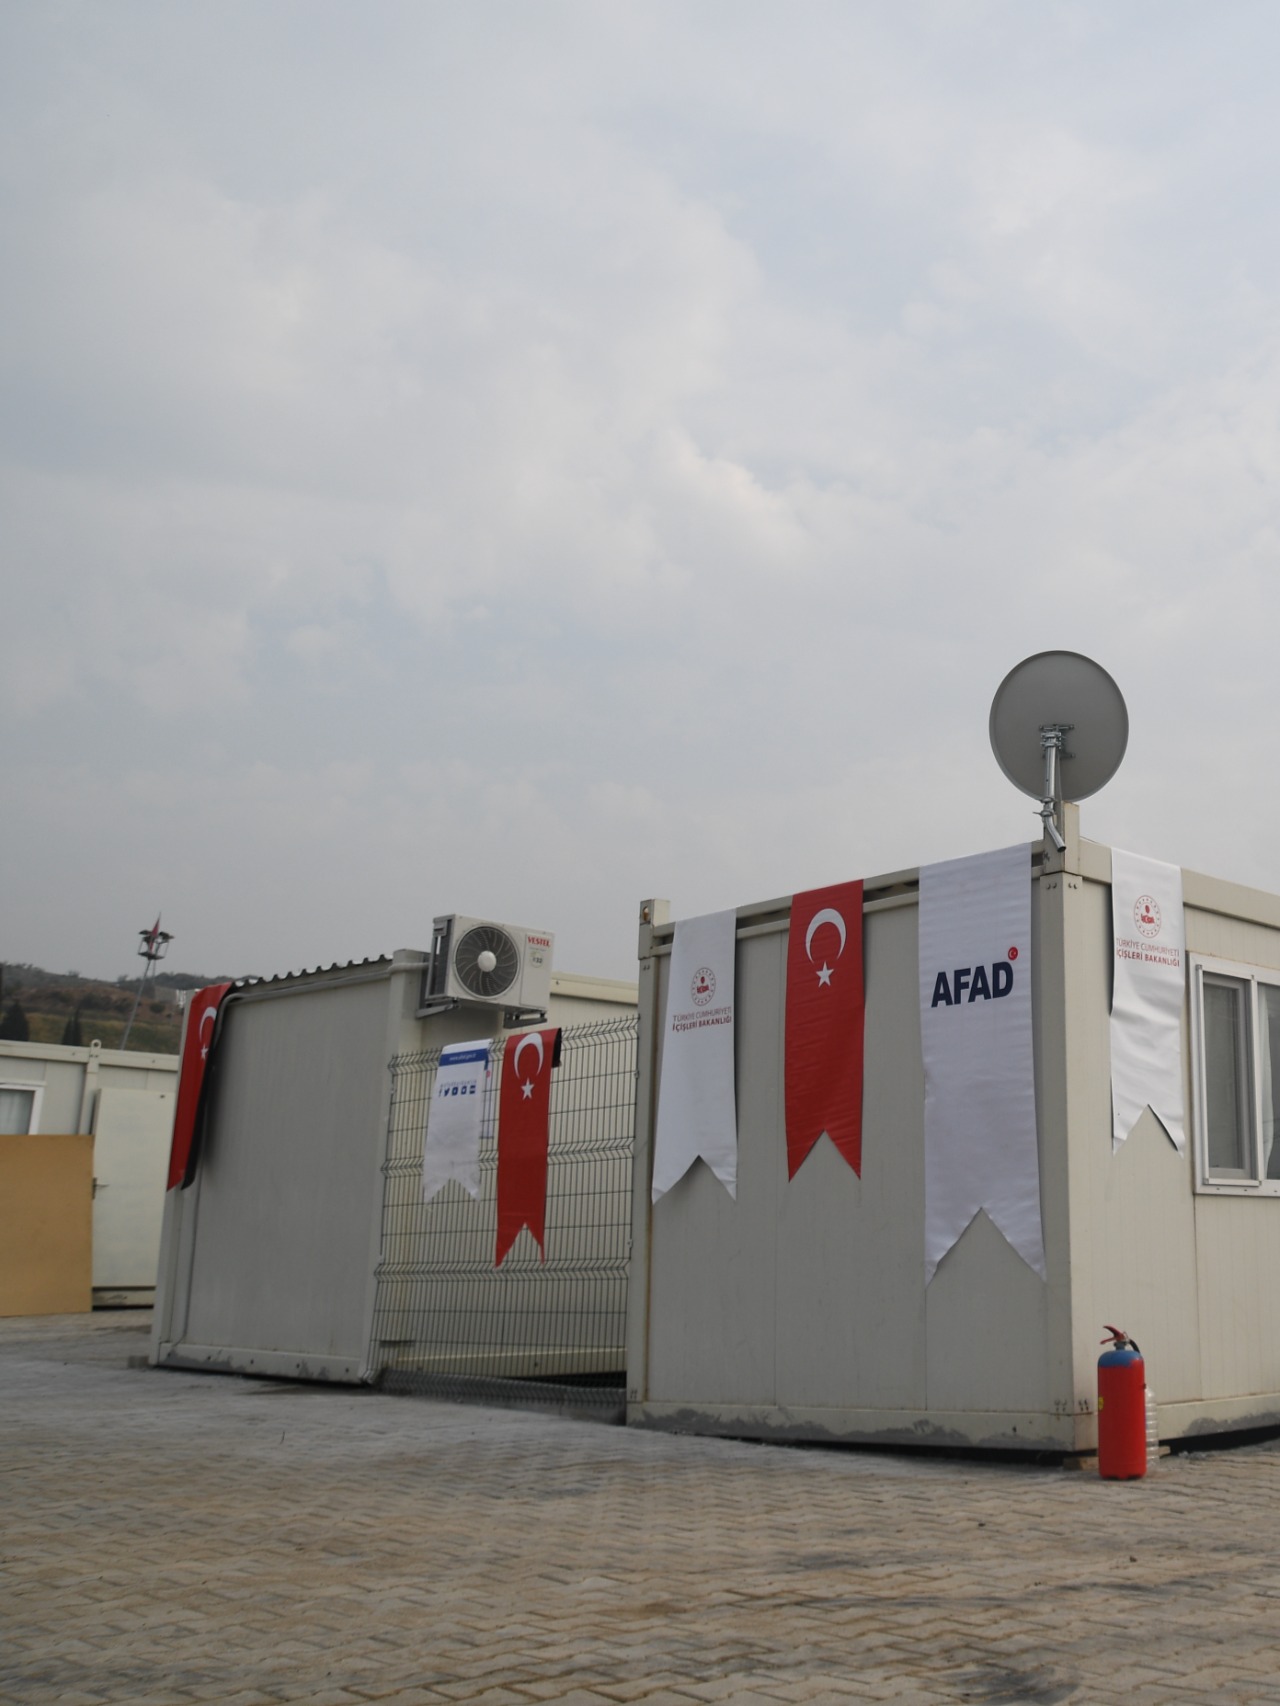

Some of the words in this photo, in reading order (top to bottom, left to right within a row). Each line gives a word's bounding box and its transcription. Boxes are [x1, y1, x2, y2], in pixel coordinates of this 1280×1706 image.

[527, 935, 551, 947] VESTEL
[1116, 938, 1140, 950] TÜRKİYE
[1141, 943, 1179, 957] CUMHURİYETİ
[1144, 953, 1180, 967] BAKANLIĞI
[931, 961, 1014, 1008] AFAD
[672, 1020, 698, 1033] İÇİŞLERİ
[699, 1015, 732, 1028] BAKANLIĞI
